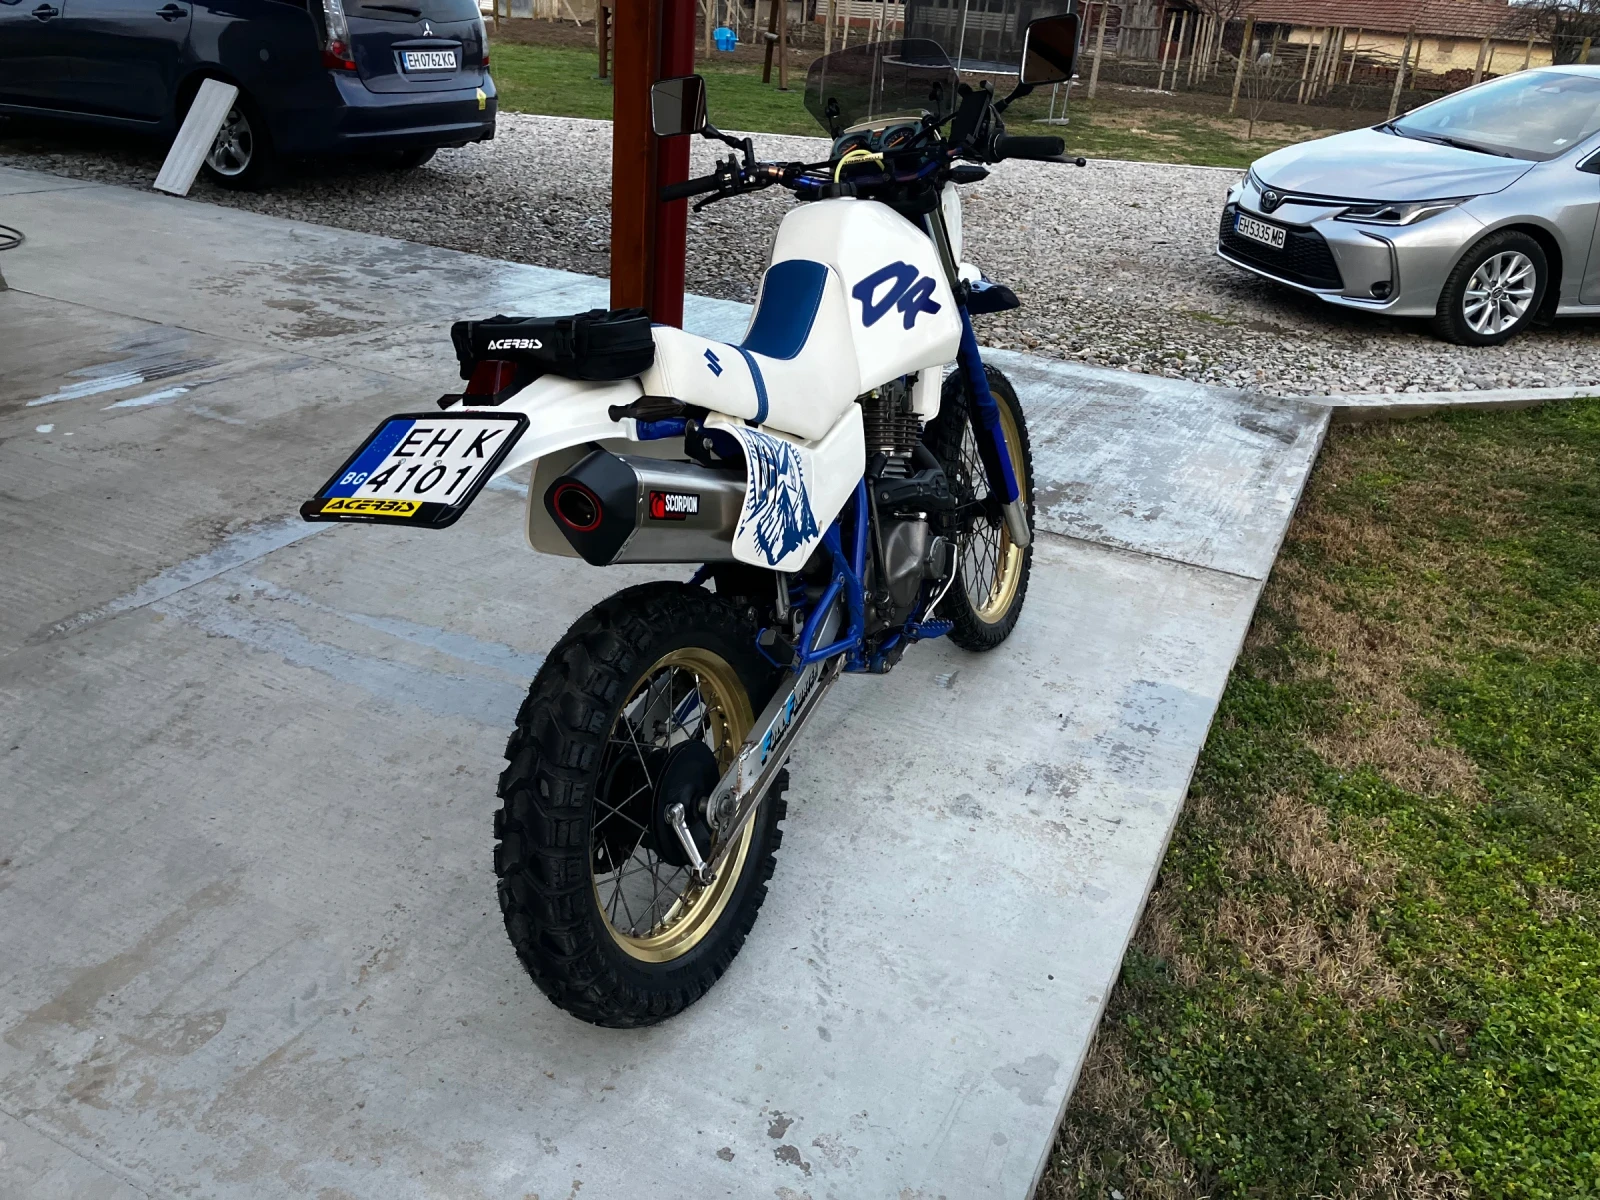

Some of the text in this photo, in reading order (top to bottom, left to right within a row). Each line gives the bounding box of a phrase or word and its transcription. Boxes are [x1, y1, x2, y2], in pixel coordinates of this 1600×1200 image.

[487, 338, 543, 350] ACERBIS
[393, 428, 505, 459] EH K
[339, 471, 368, 485] BG
[366, 463, 474, 496] 4101
[326, 499, 416, 513] ACERBIS
[665, 494, 698, 513] SCORPION
